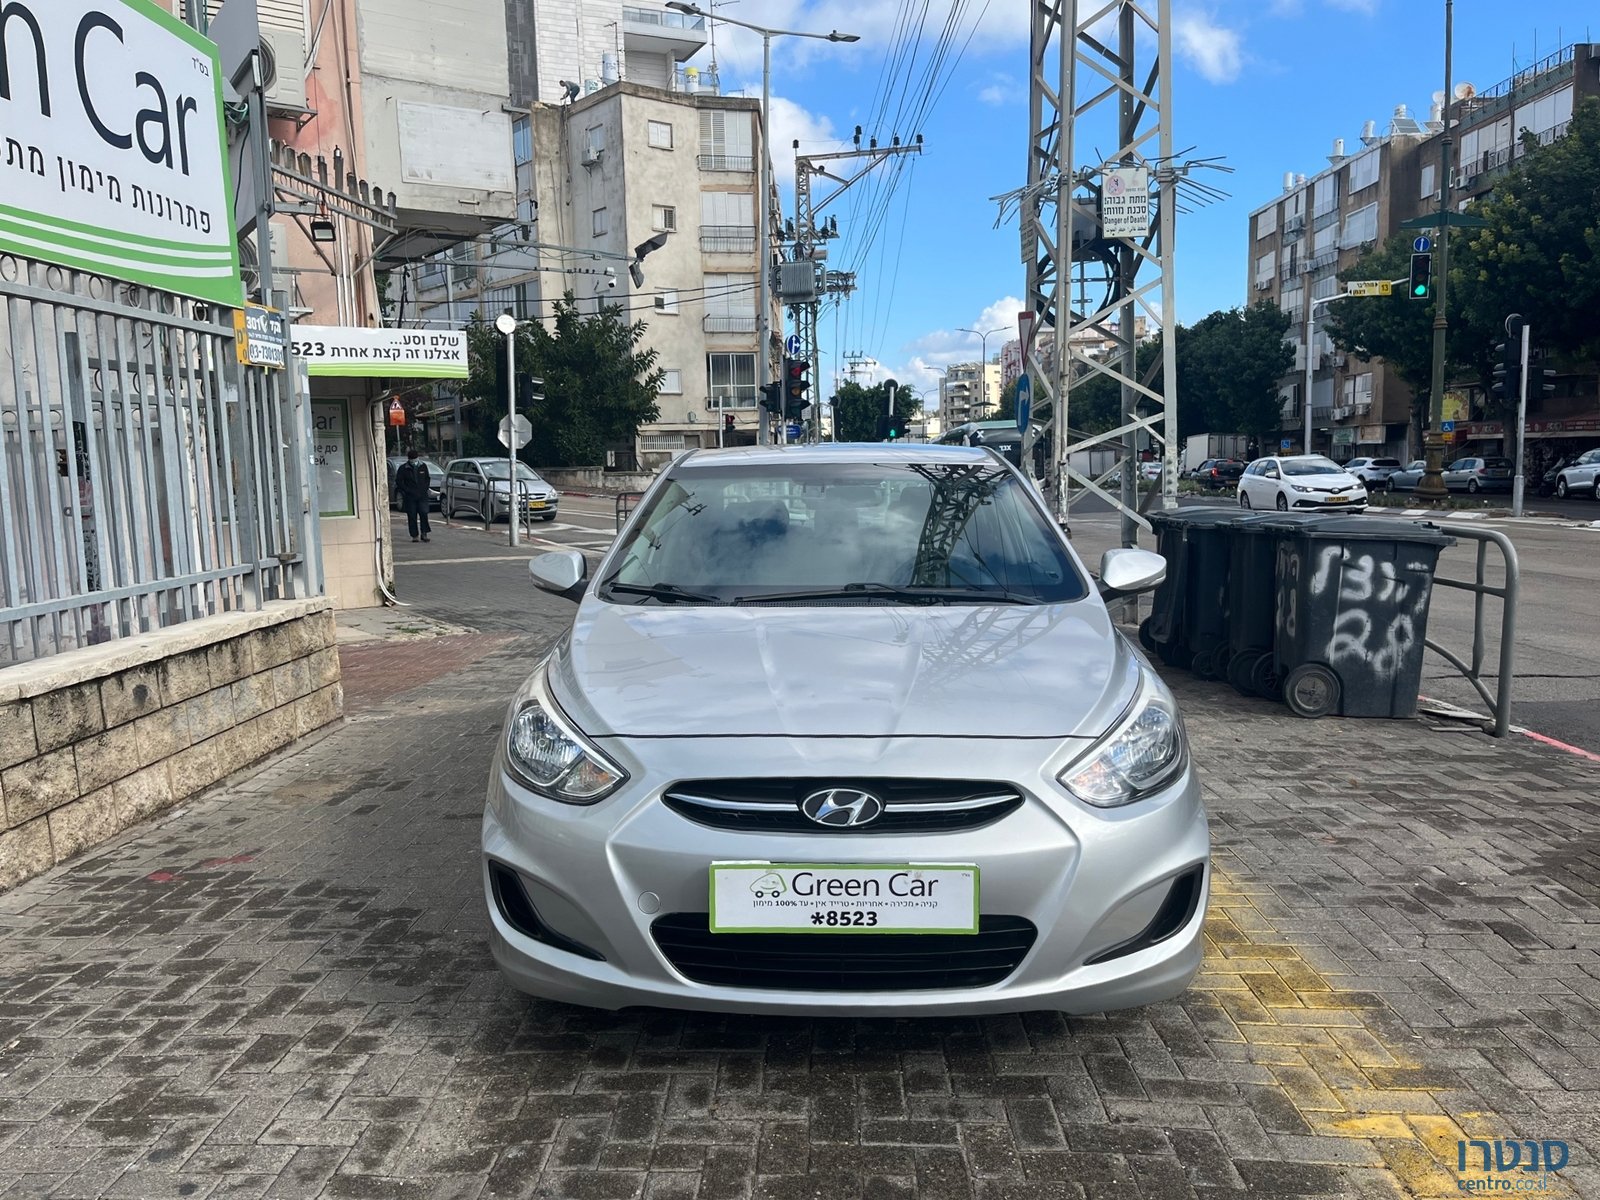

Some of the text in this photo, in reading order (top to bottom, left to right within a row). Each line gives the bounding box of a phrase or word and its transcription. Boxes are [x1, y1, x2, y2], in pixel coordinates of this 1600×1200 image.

[74, 11, 198, 177] Car
[0, 137, 211, 234] פתרונות מימון מת
[1129, 195, 1147, 204] מתח
[1127, 205, 1147, 215] סכנת
[1104, 216, 1123, 226] Danger
[1123, 216, 1129, 224] of
[246, 316, 261, 331] 301
[389, 335, 426, 346] וסע...
[430, 334, 459, 346] שלם
[330, 346, 368, 358] אחרת
[373, 347, 401, 361] קצת
[405, 349, 420, 359] זה
[424, 347, 460, 360] אצלנו
[312, 411, 337, 430] ar
[791, 872, 939, 897] Green Car
[753, 900, 773, 909] מימון
[799, 900, 809, 908] עד
[815, 900, 827, 909] אין
[856, 900, 883, 908] אחריות
[890, 900, 914, 908] מכירה
[920, 900, 938, 908] קניה
